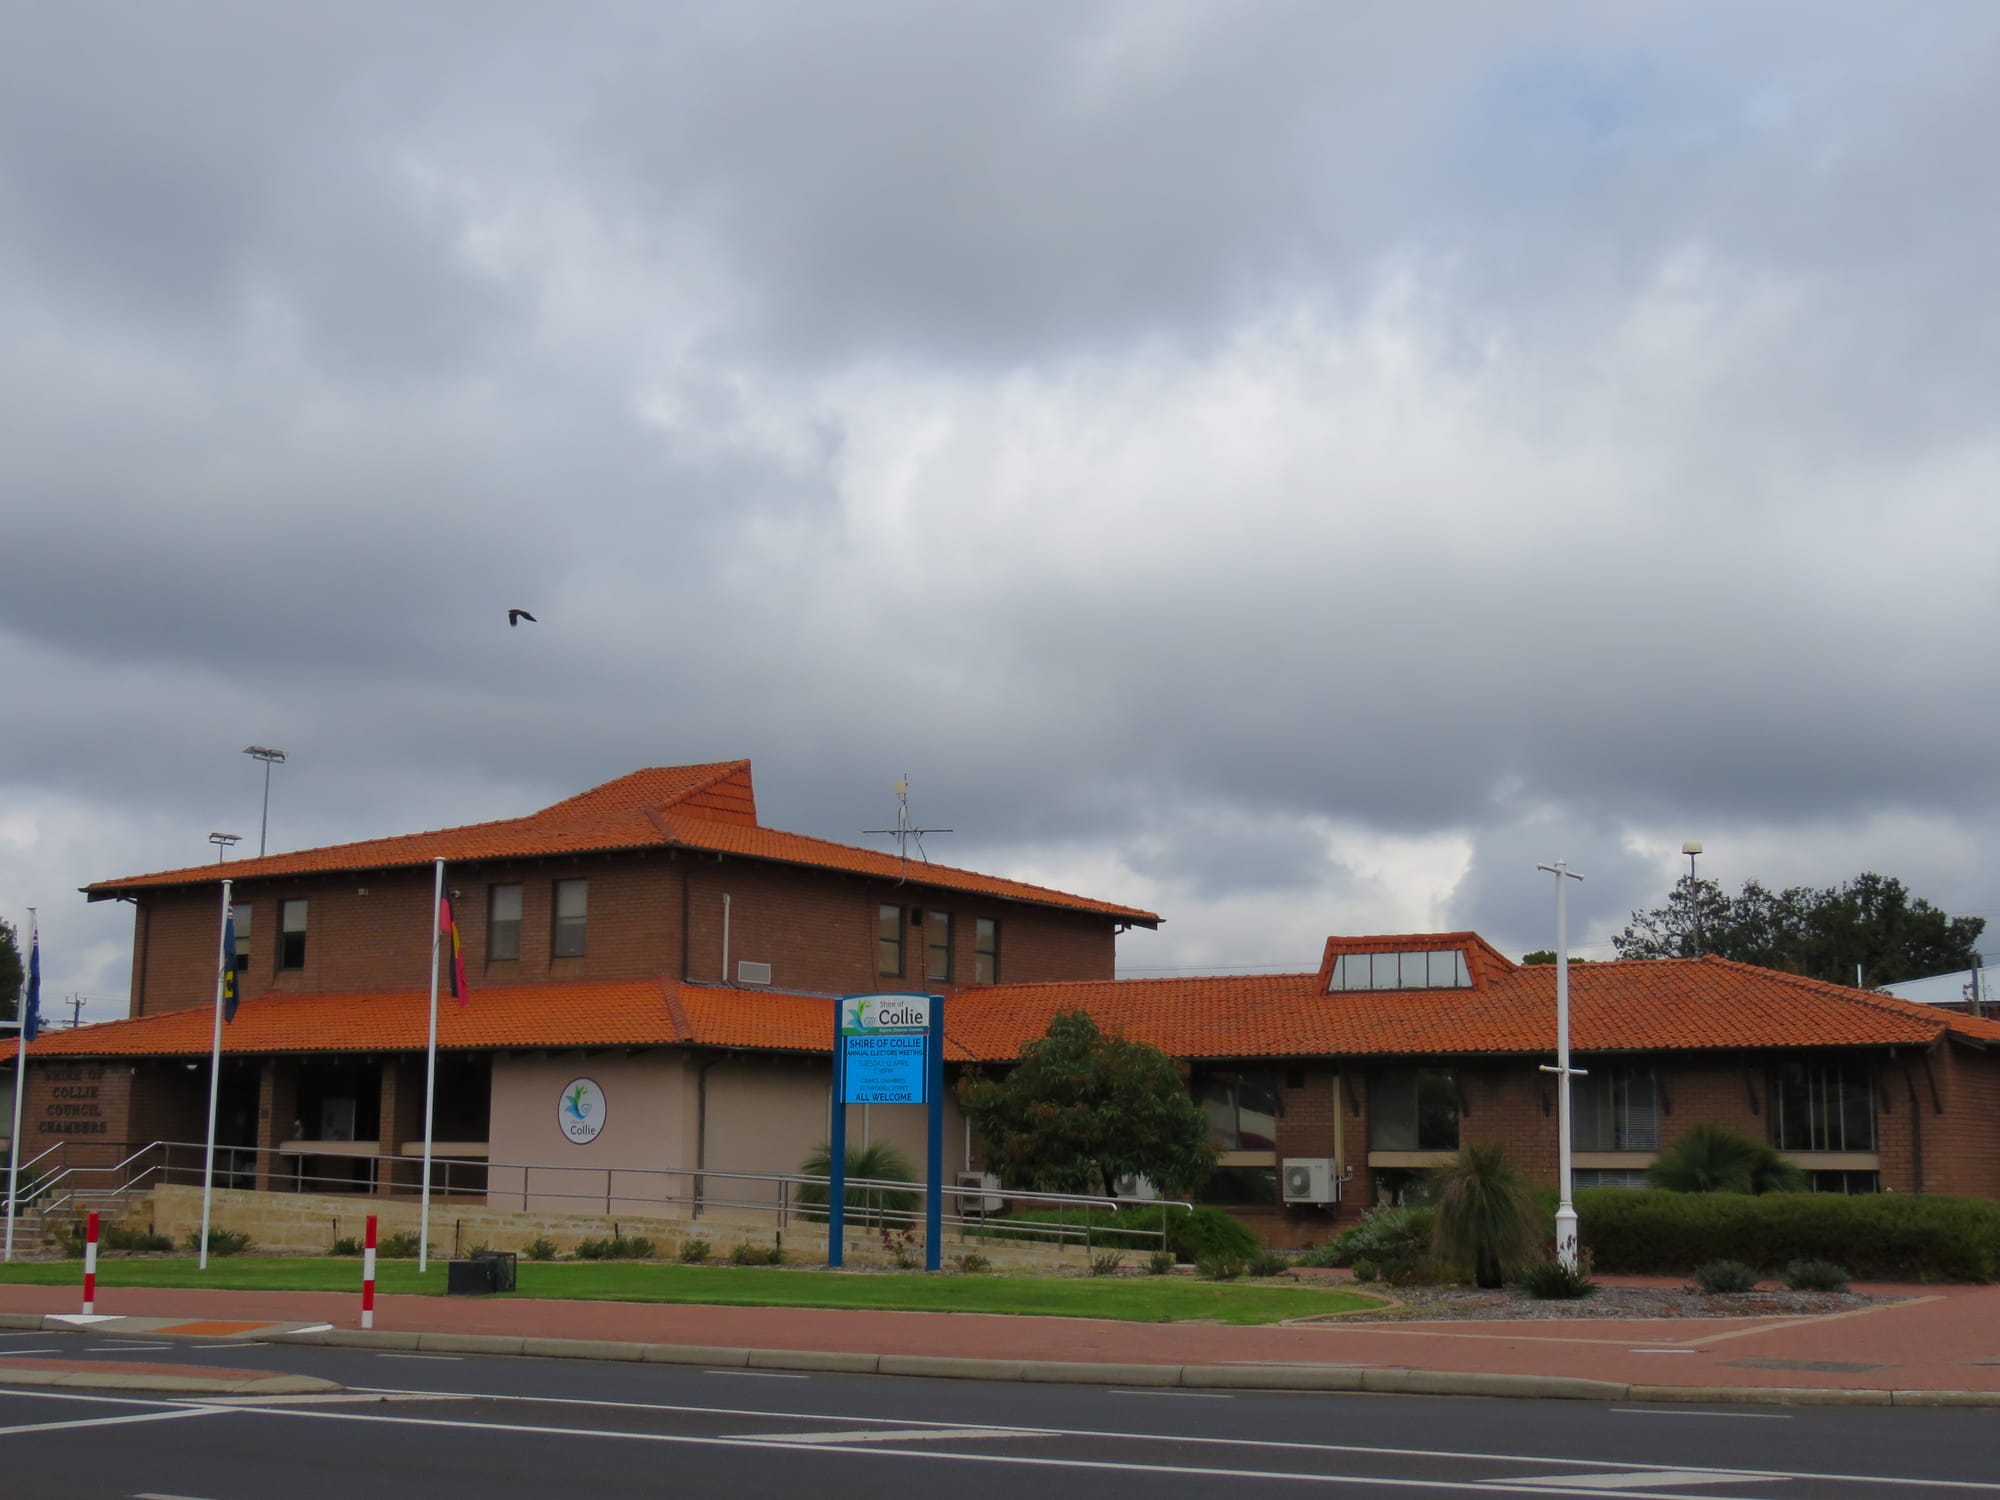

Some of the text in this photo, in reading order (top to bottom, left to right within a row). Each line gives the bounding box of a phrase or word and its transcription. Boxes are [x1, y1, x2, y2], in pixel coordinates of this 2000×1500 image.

[879, 1006, 923, 1025] Collie
[849, 1038, 921, 1048] SHIRE OF COLLIE
[52, 1087, 99, 1098] COLLIE
[856, 1092, 912, 1101] ALL WELCOME
[47, 1103, 102, 1117] COUNCIL
[39, 1121, 107, 1134] CHAMBERS
[570, 1123, 596, 1135] Collie
